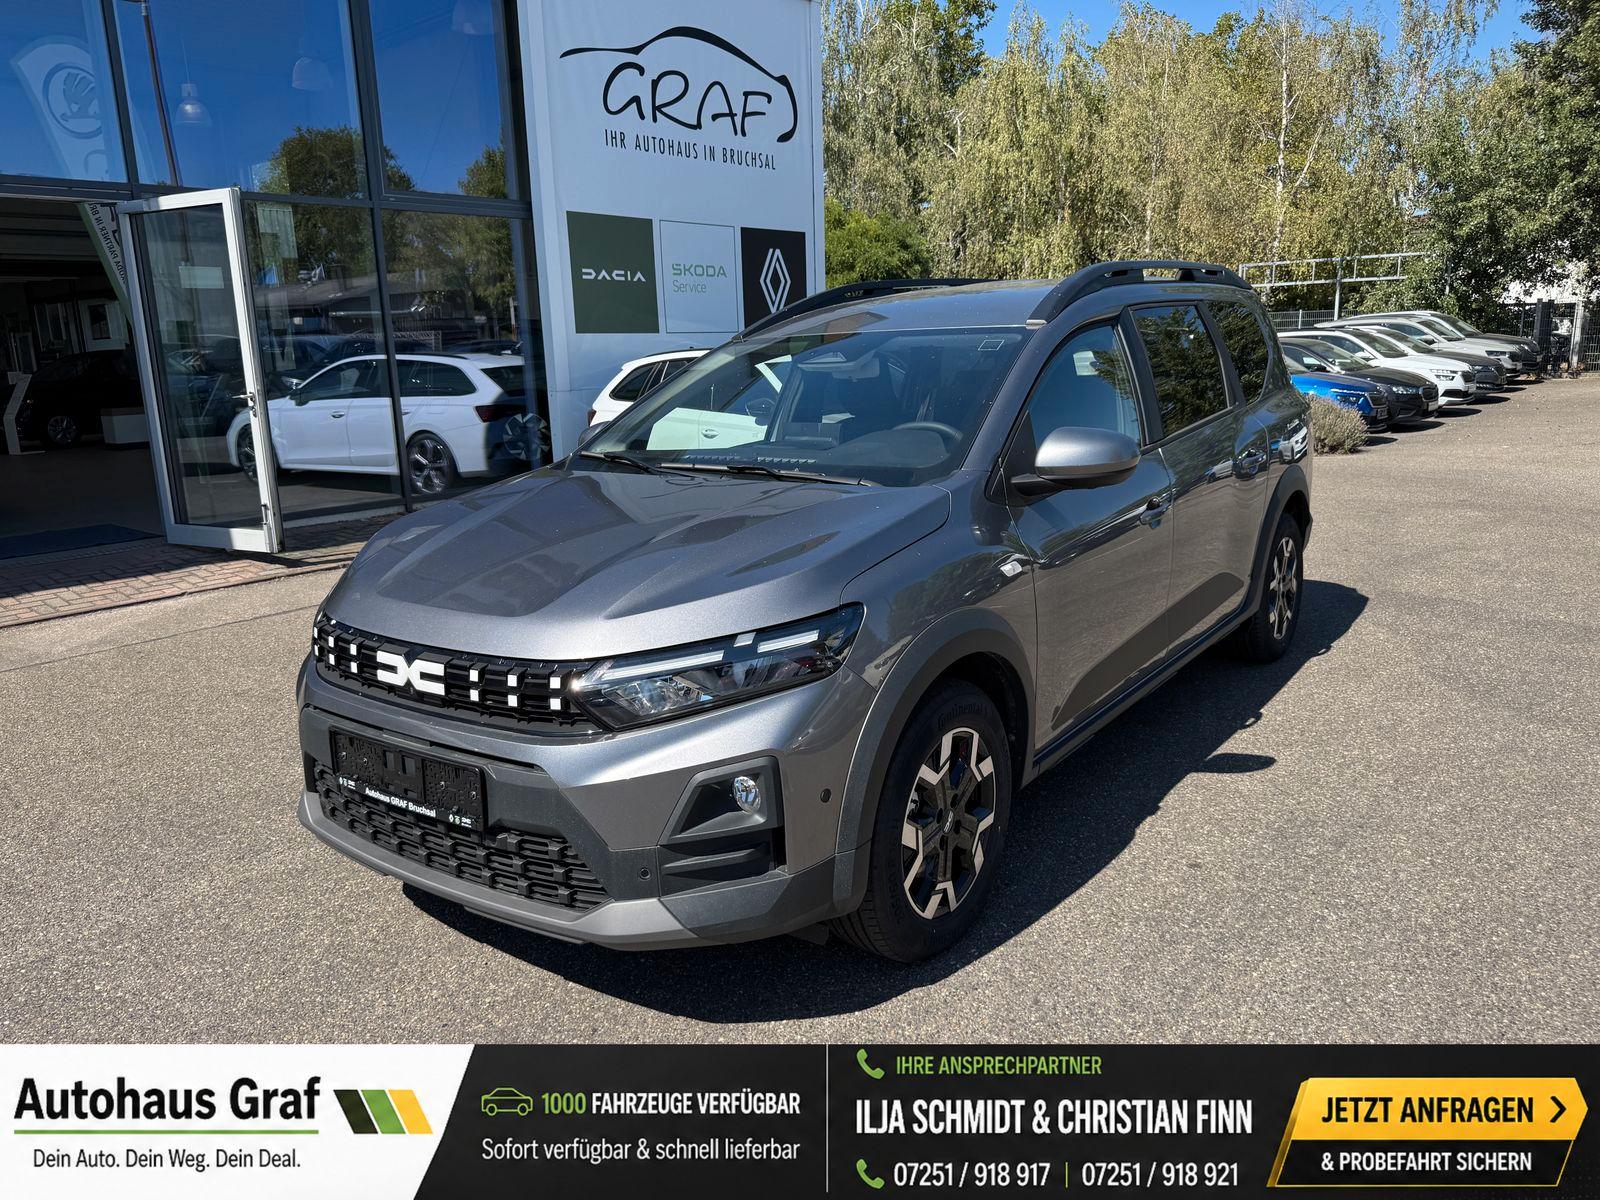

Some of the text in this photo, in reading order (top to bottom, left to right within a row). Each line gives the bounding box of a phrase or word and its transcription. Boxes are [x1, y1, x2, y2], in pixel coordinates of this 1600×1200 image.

[602, 61, 772, 138] GRAF
[604, 129, 776, 171] IHR AUTOHAUS IN BRUCHSAL
[581, 267, 647, 283] DACIA
[672, 279, 707, 294] Service
[365, 787, 436, 818] Autohaus GRAF Bruchsal
